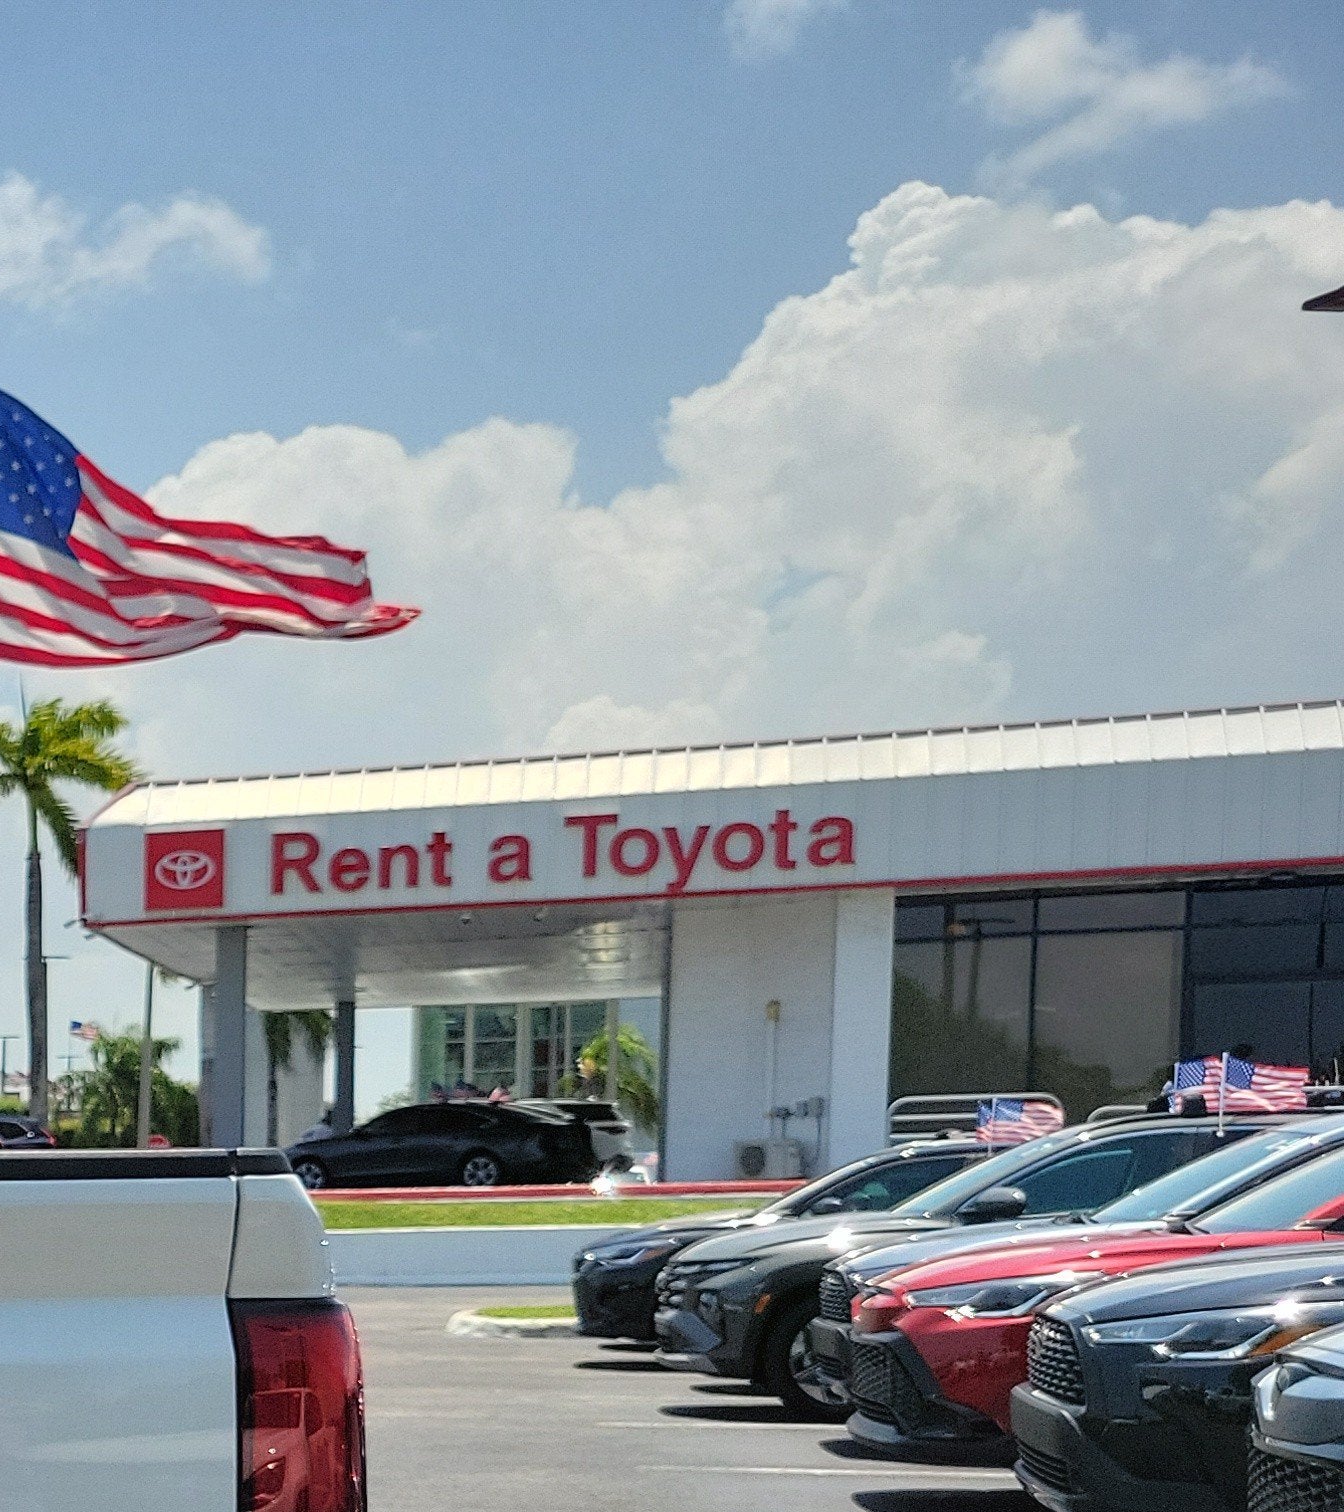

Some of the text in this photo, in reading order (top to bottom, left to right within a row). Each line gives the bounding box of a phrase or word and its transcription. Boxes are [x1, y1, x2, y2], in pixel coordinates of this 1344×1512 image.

[270, 809, 856, 896] Rent a Toyota
